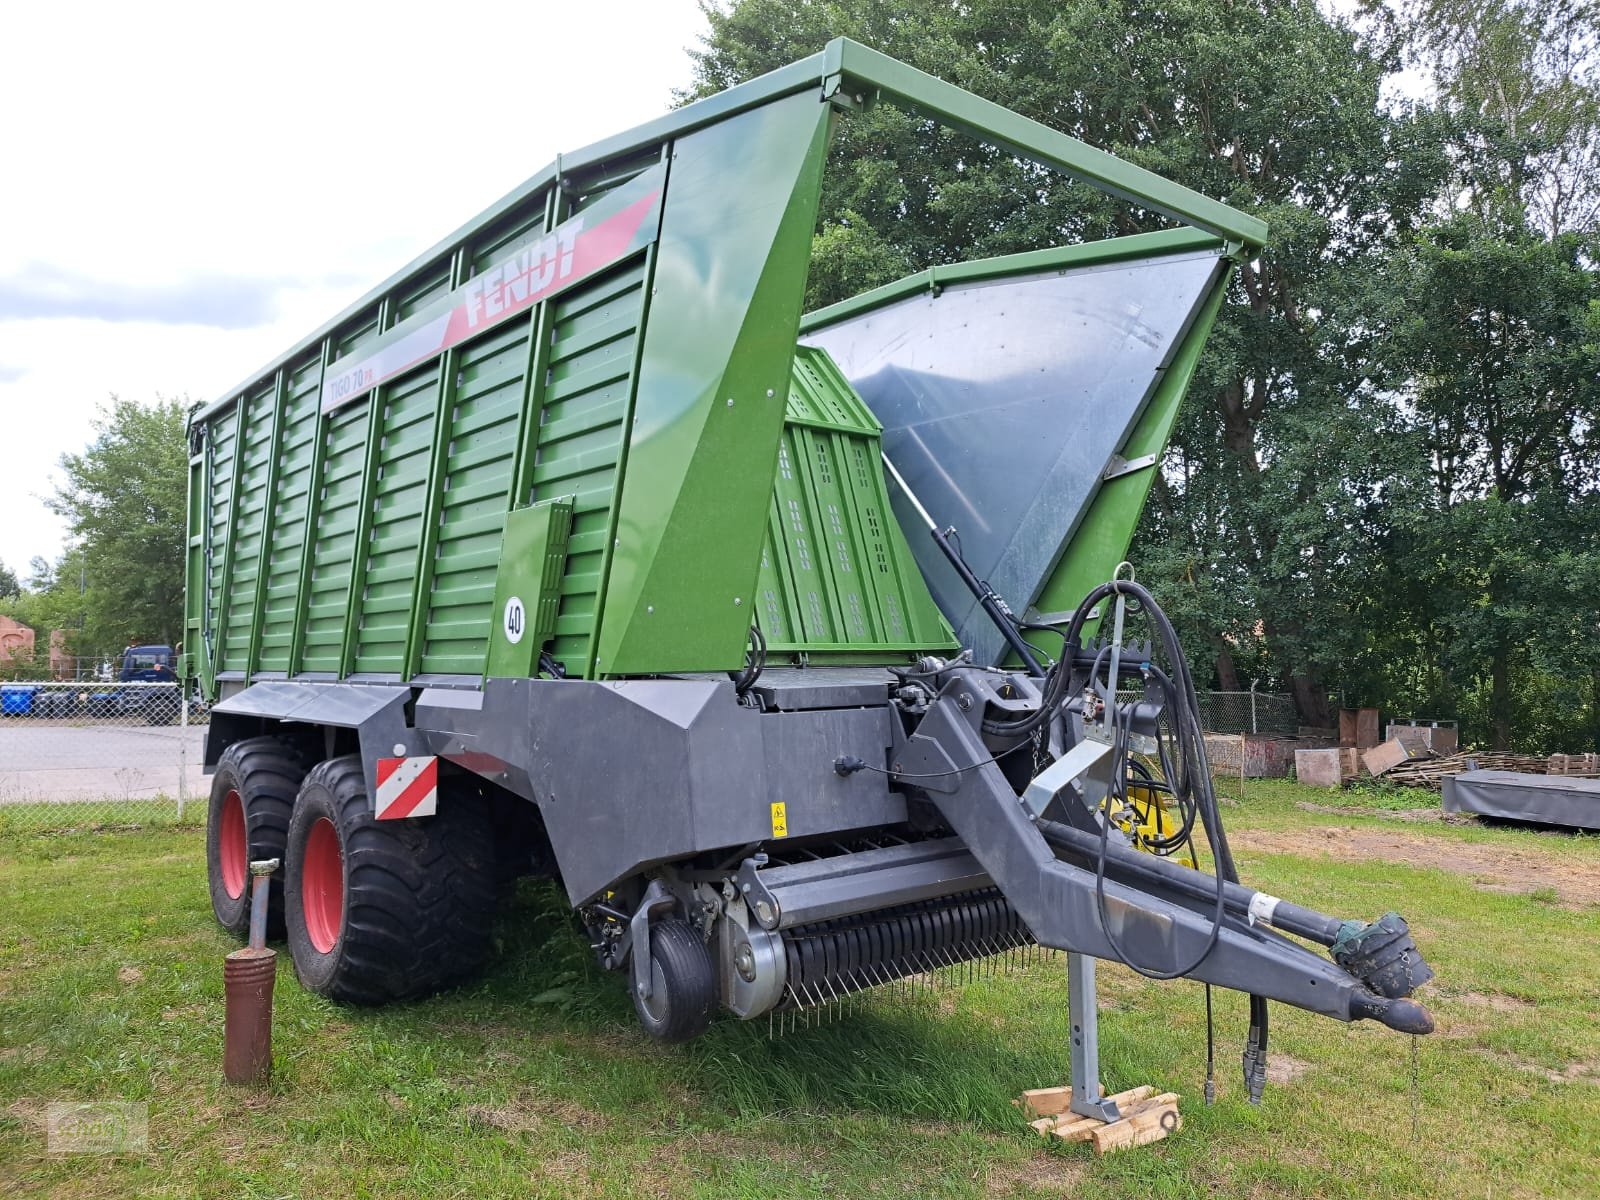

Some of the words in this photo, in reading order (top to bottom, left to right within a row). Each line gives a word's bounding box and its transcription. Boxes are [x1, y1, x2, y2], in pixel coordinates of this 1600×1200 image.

[464, 216, 584, 328] FENDT
[331, 375, 350, 401] TIGO
[508, 606, 521, 635] 40
